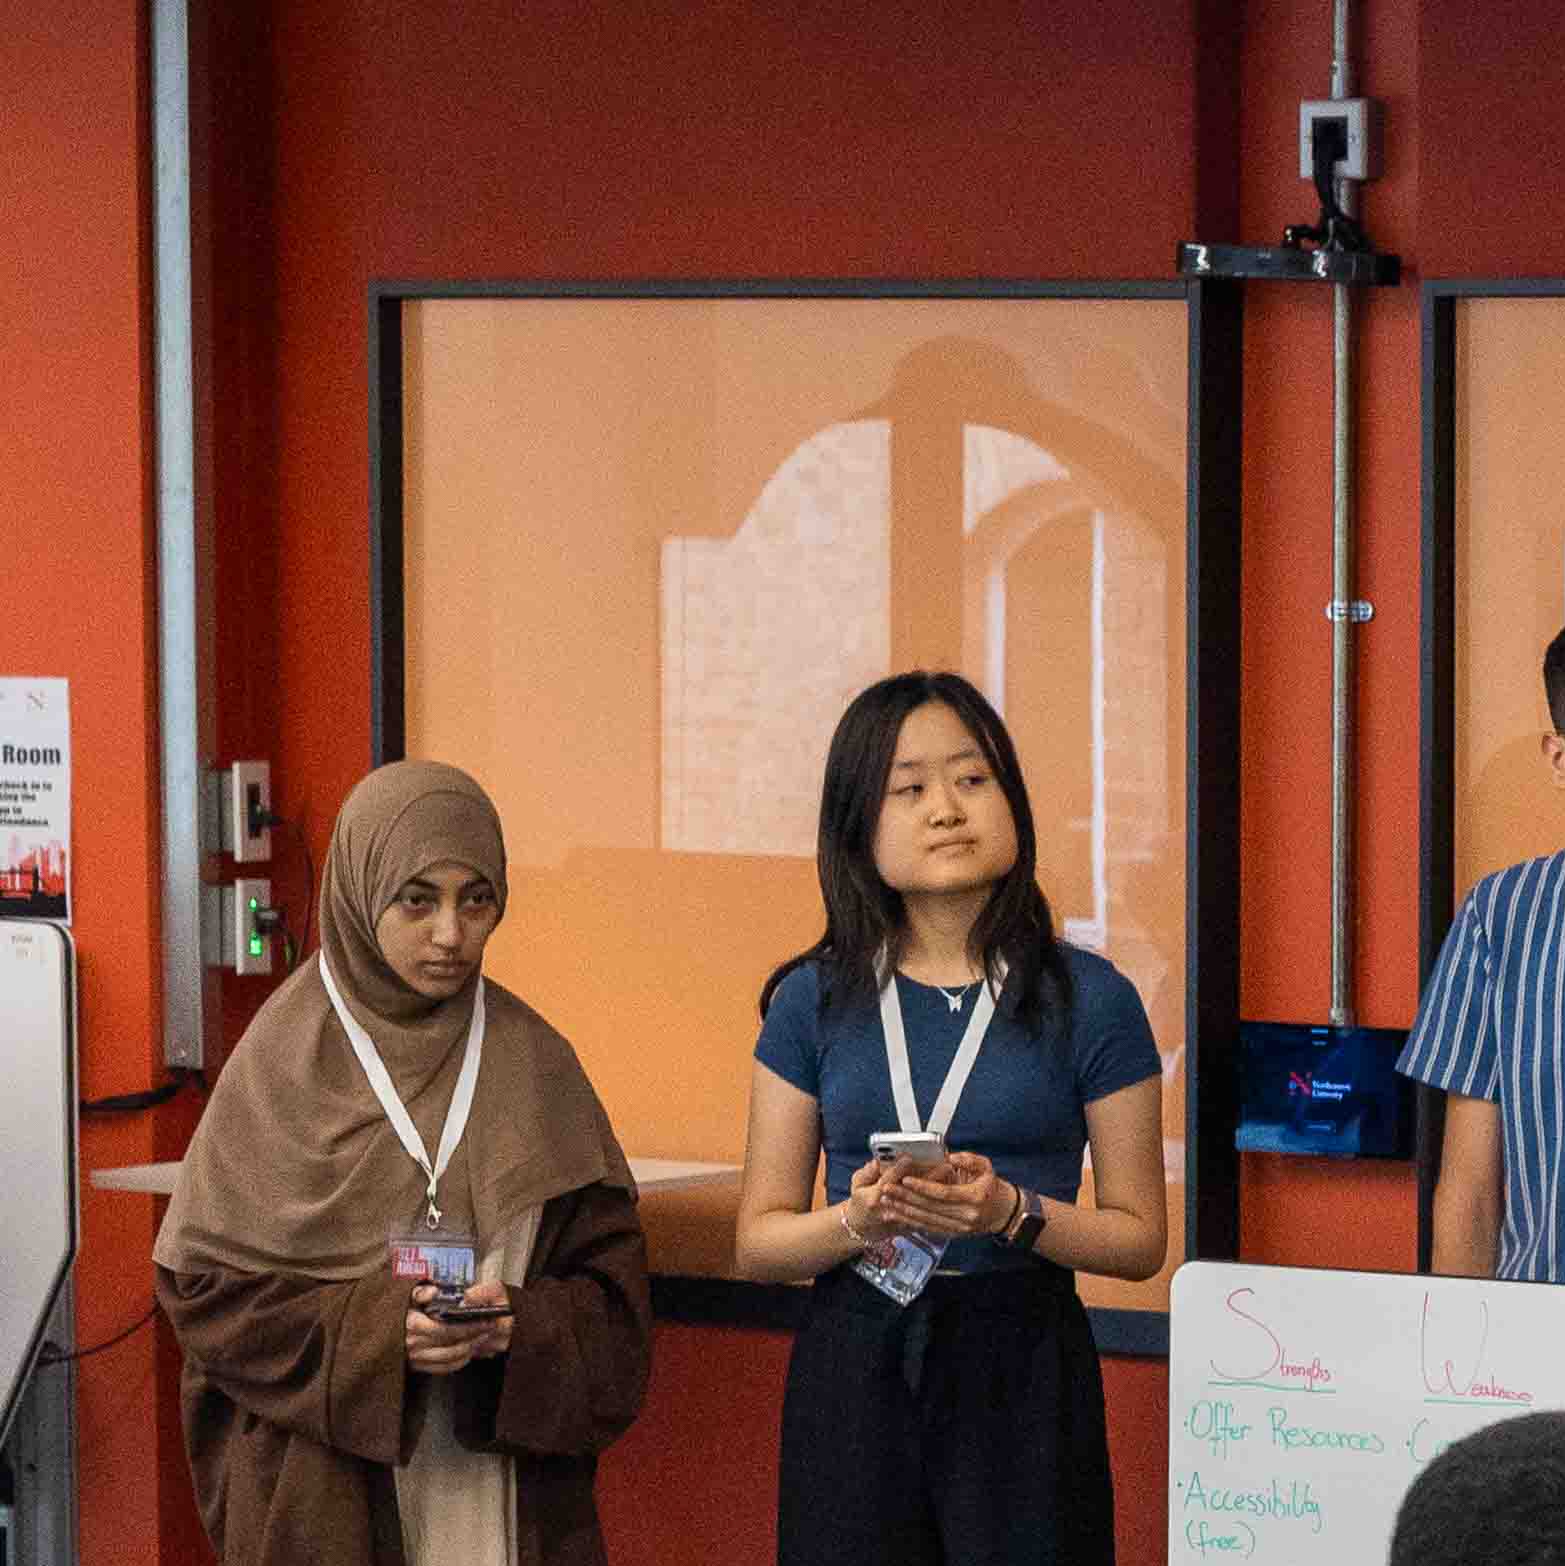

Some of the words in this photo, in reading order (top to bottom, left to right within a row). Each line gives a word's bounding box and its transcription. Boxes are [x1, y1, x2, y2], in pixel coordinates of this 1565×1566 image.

[2, 744, 61, 766] Room
[1190, 1399, 1253, 1462] Offer
[1267, 1405, 1385, 1455] Resources
[1183, 1470, 1323, 1535] Accessibility
